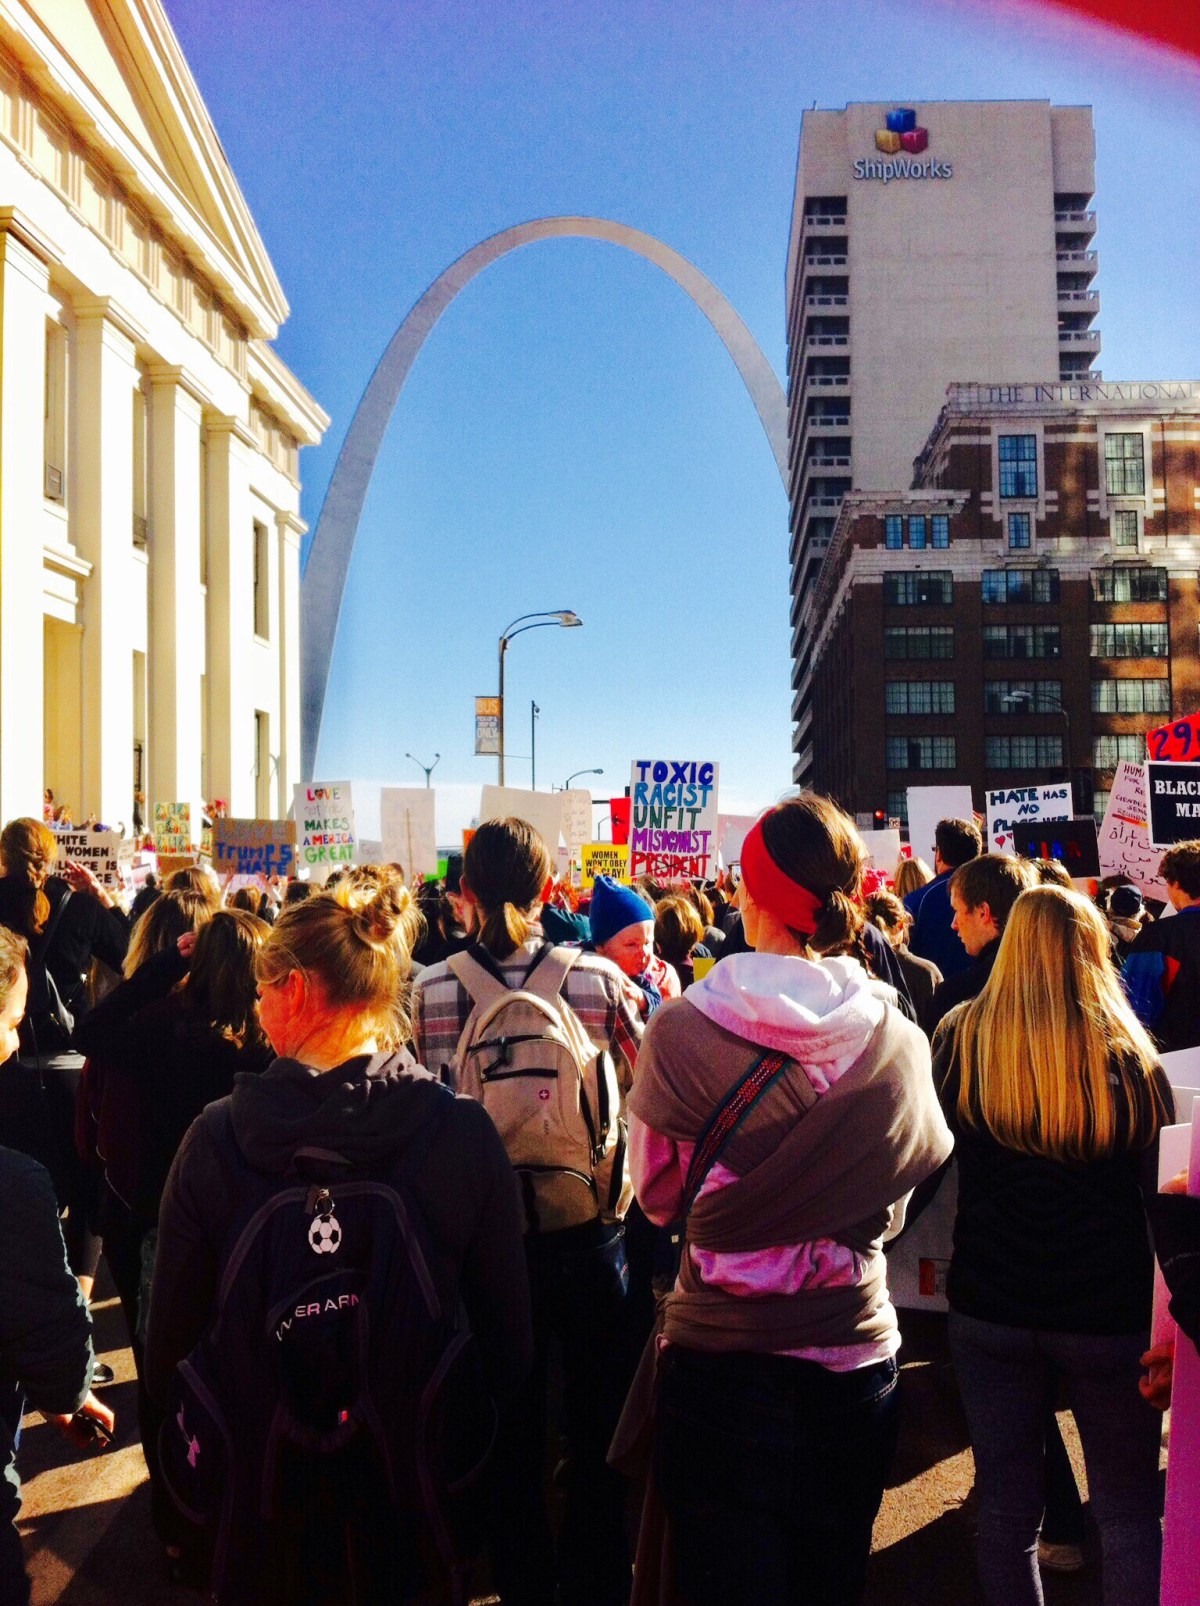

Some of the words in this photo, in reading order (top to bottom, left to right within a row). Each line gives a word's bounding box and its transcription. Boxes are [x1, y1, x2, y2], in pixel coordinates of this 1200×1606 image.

[853, 157, 953, 185] ShipWorks
[989, 386, 1023, 402] THE
[1035, 384, 1198, 401] INTERNATIONAL
[1154, 722, 1200, 761] 29
[636, 760, 714, 785] TOXIC
[634, 782, 713, 808] RACIST
[990, 787, 1039, 806] HATE
[1043, 789, 1067, 800] HAS
[633, 806, 702, 830] UNFIT
[1017, 803, 1040, 815] NO
[304, 817, 350, 831] MAKES
[54, 835, 87, 845] HITE
[303, 832, 354, 846] AMERICA
[304, 844, 354, 864] GREAT
[586, 859, 608, 867] WON'T
[609, 859, 628, 867] OBEY
[591, 851, 618, 859] WOMEN
[105, 861, 117, 870] IS
[586, 868, 595, 878] W
[630, 851, 711, 879] PRESIDENT
